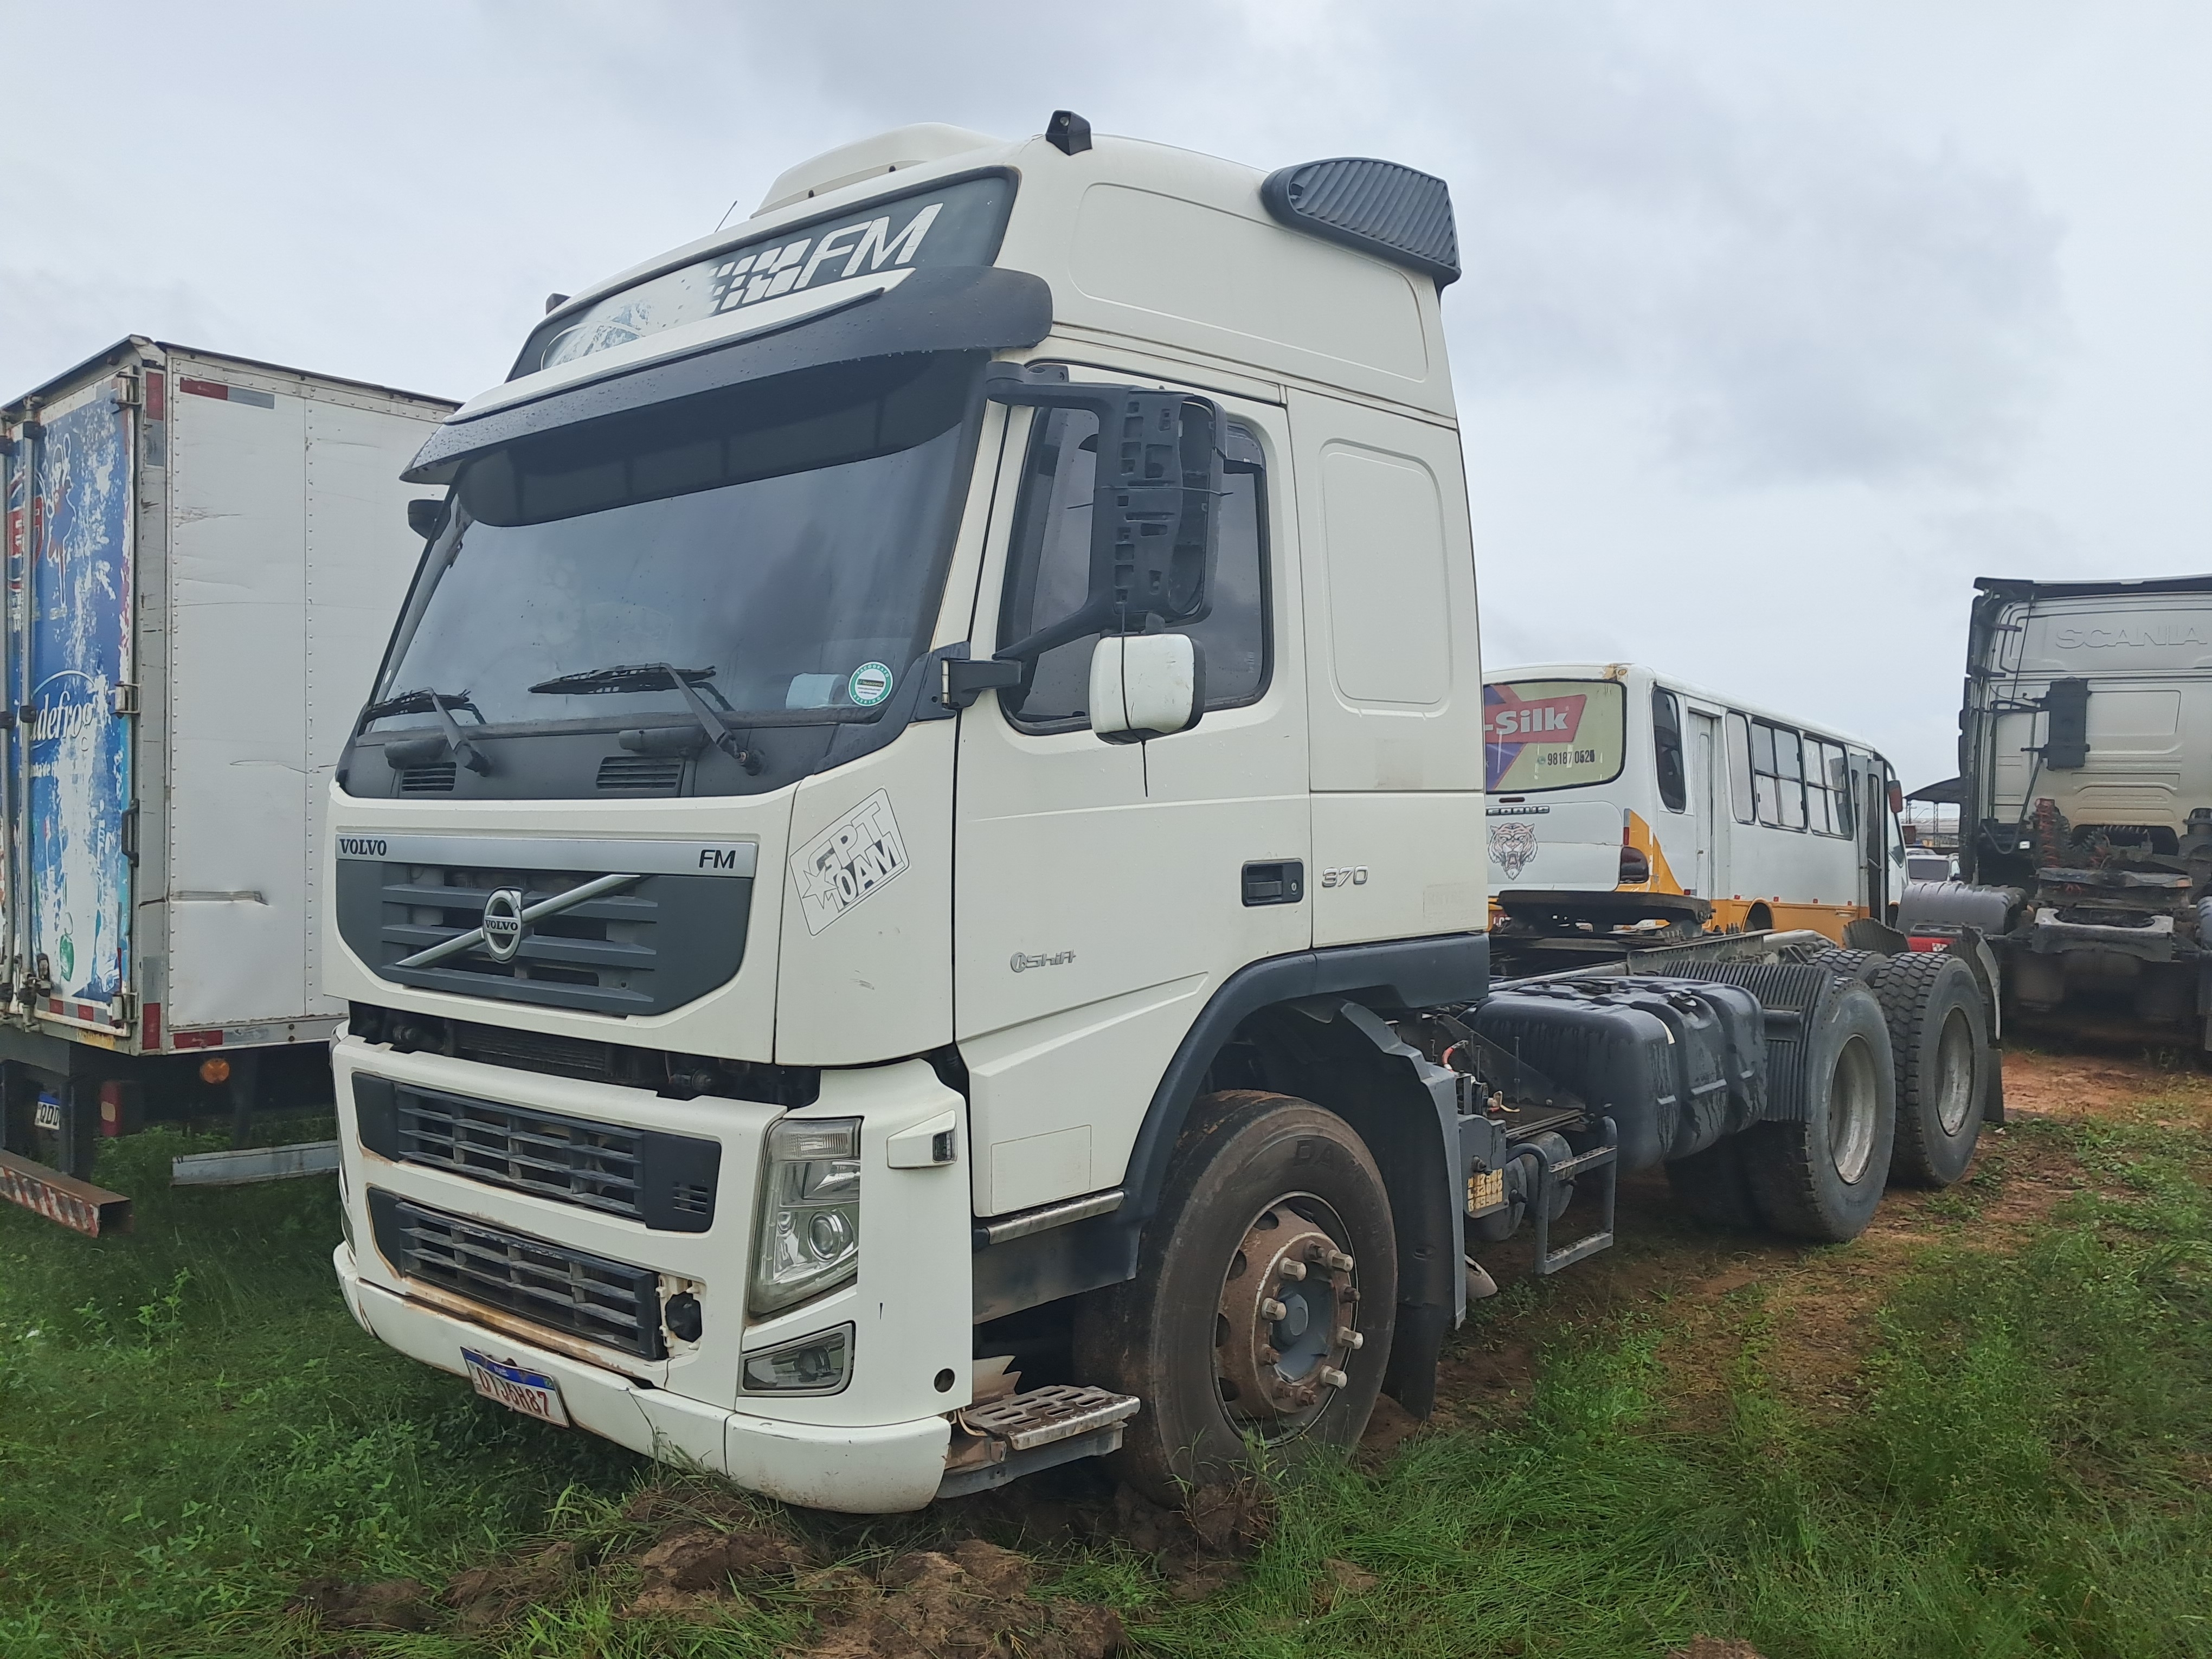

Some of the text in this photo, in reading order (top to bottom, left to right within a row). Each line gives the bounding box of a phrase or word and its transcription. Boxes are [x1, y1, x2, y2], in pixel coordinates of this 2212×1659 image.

[794, 203, 944, 290] FM
[2056, 625, 2208, 649] SCANIA
[339, 839, 387, 856] VOLVO
[699, 849, 736, 869] FM
[1322, 865, 1368, 888] 370
[485, 919, 518, 931] VOLVO
